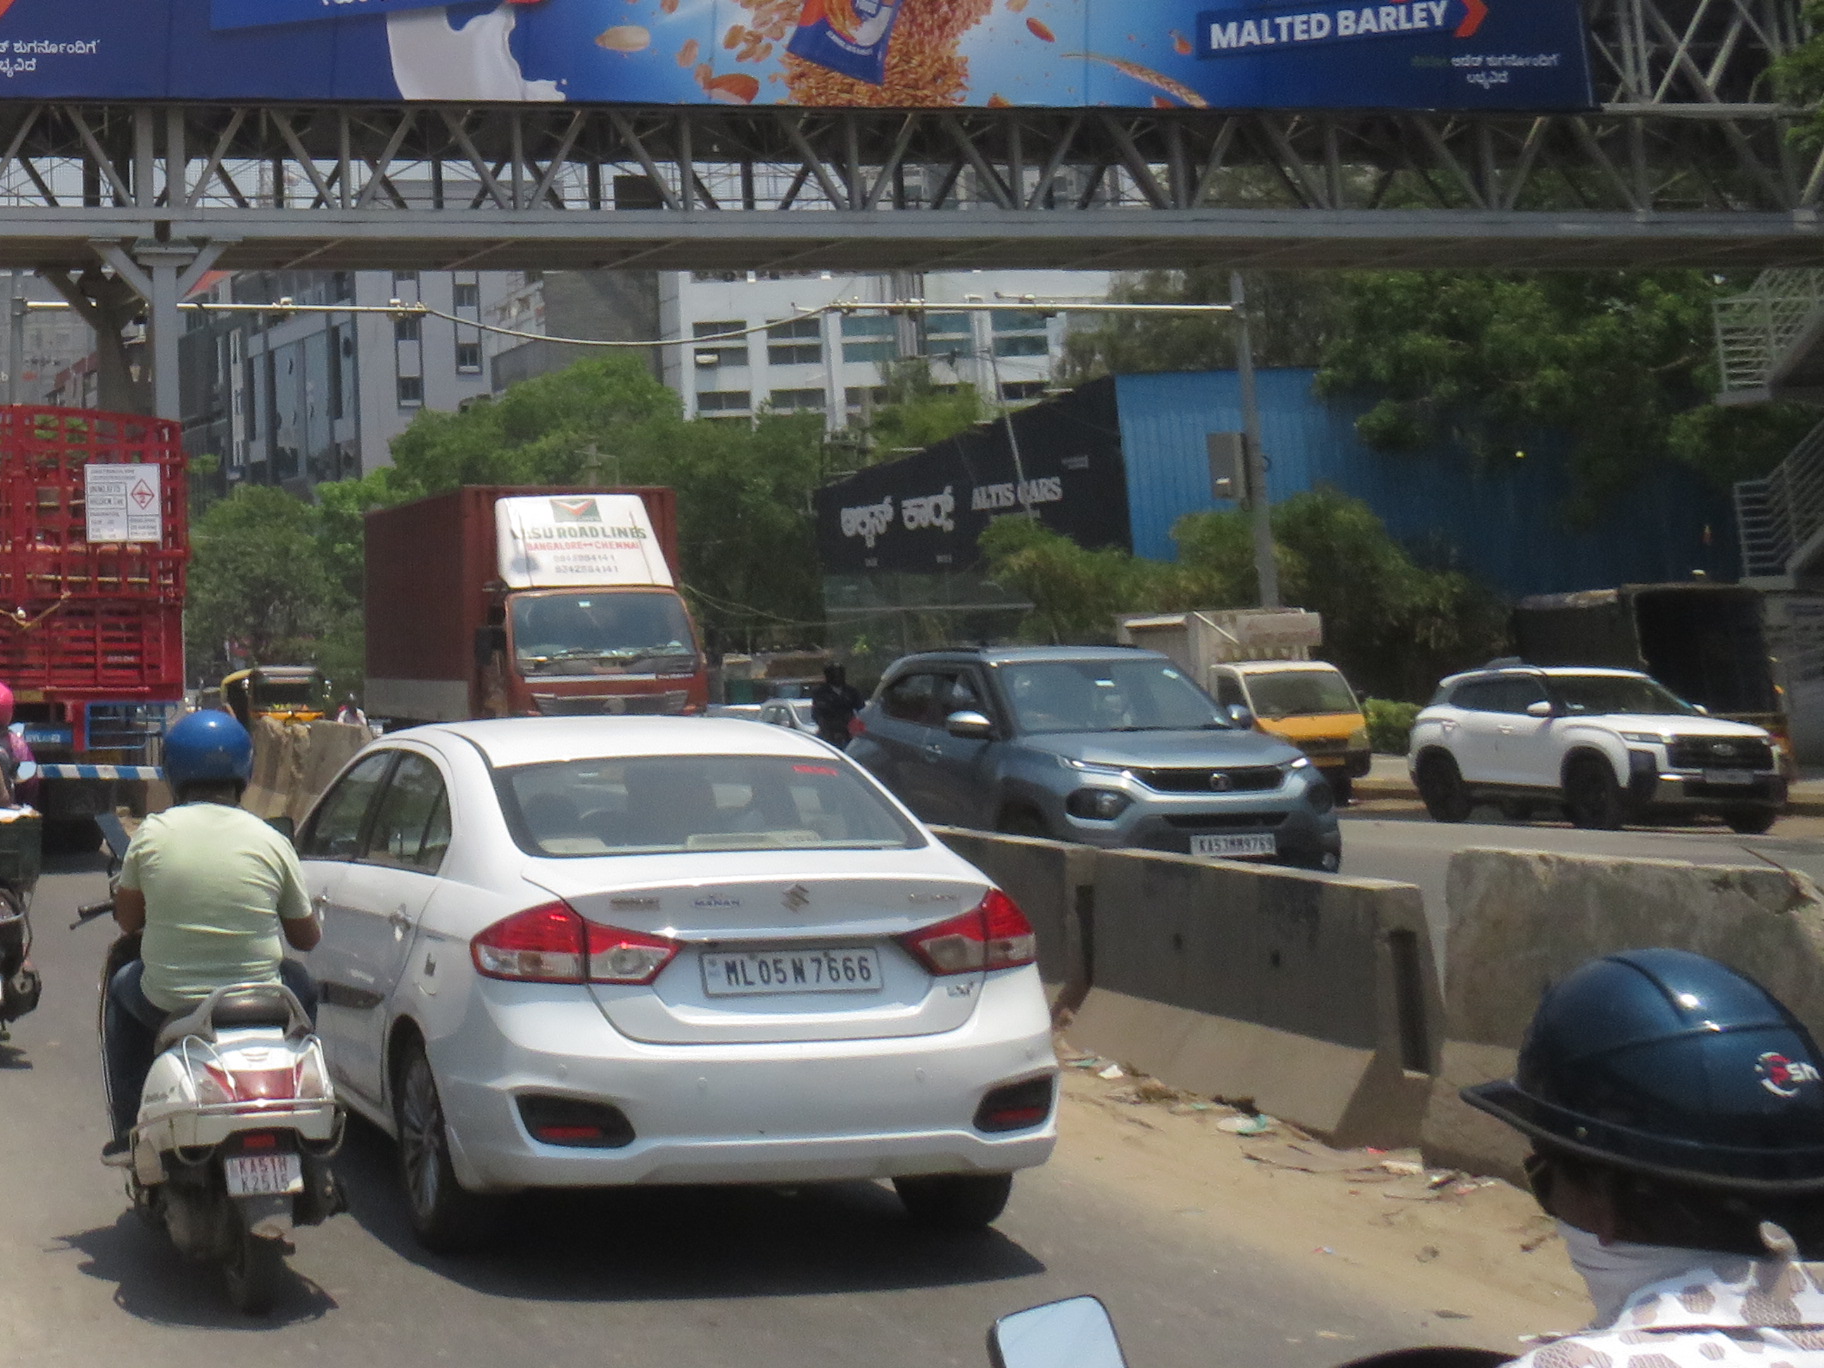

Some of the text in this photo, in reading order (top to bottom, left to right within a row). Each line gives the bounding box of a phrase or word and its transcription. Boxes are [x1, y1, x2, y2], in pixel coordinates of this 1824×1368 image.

[1210, 0, 1449, 50] MALTED BARLEY
[971, 476, 1063, 510] ALTIS CARS
